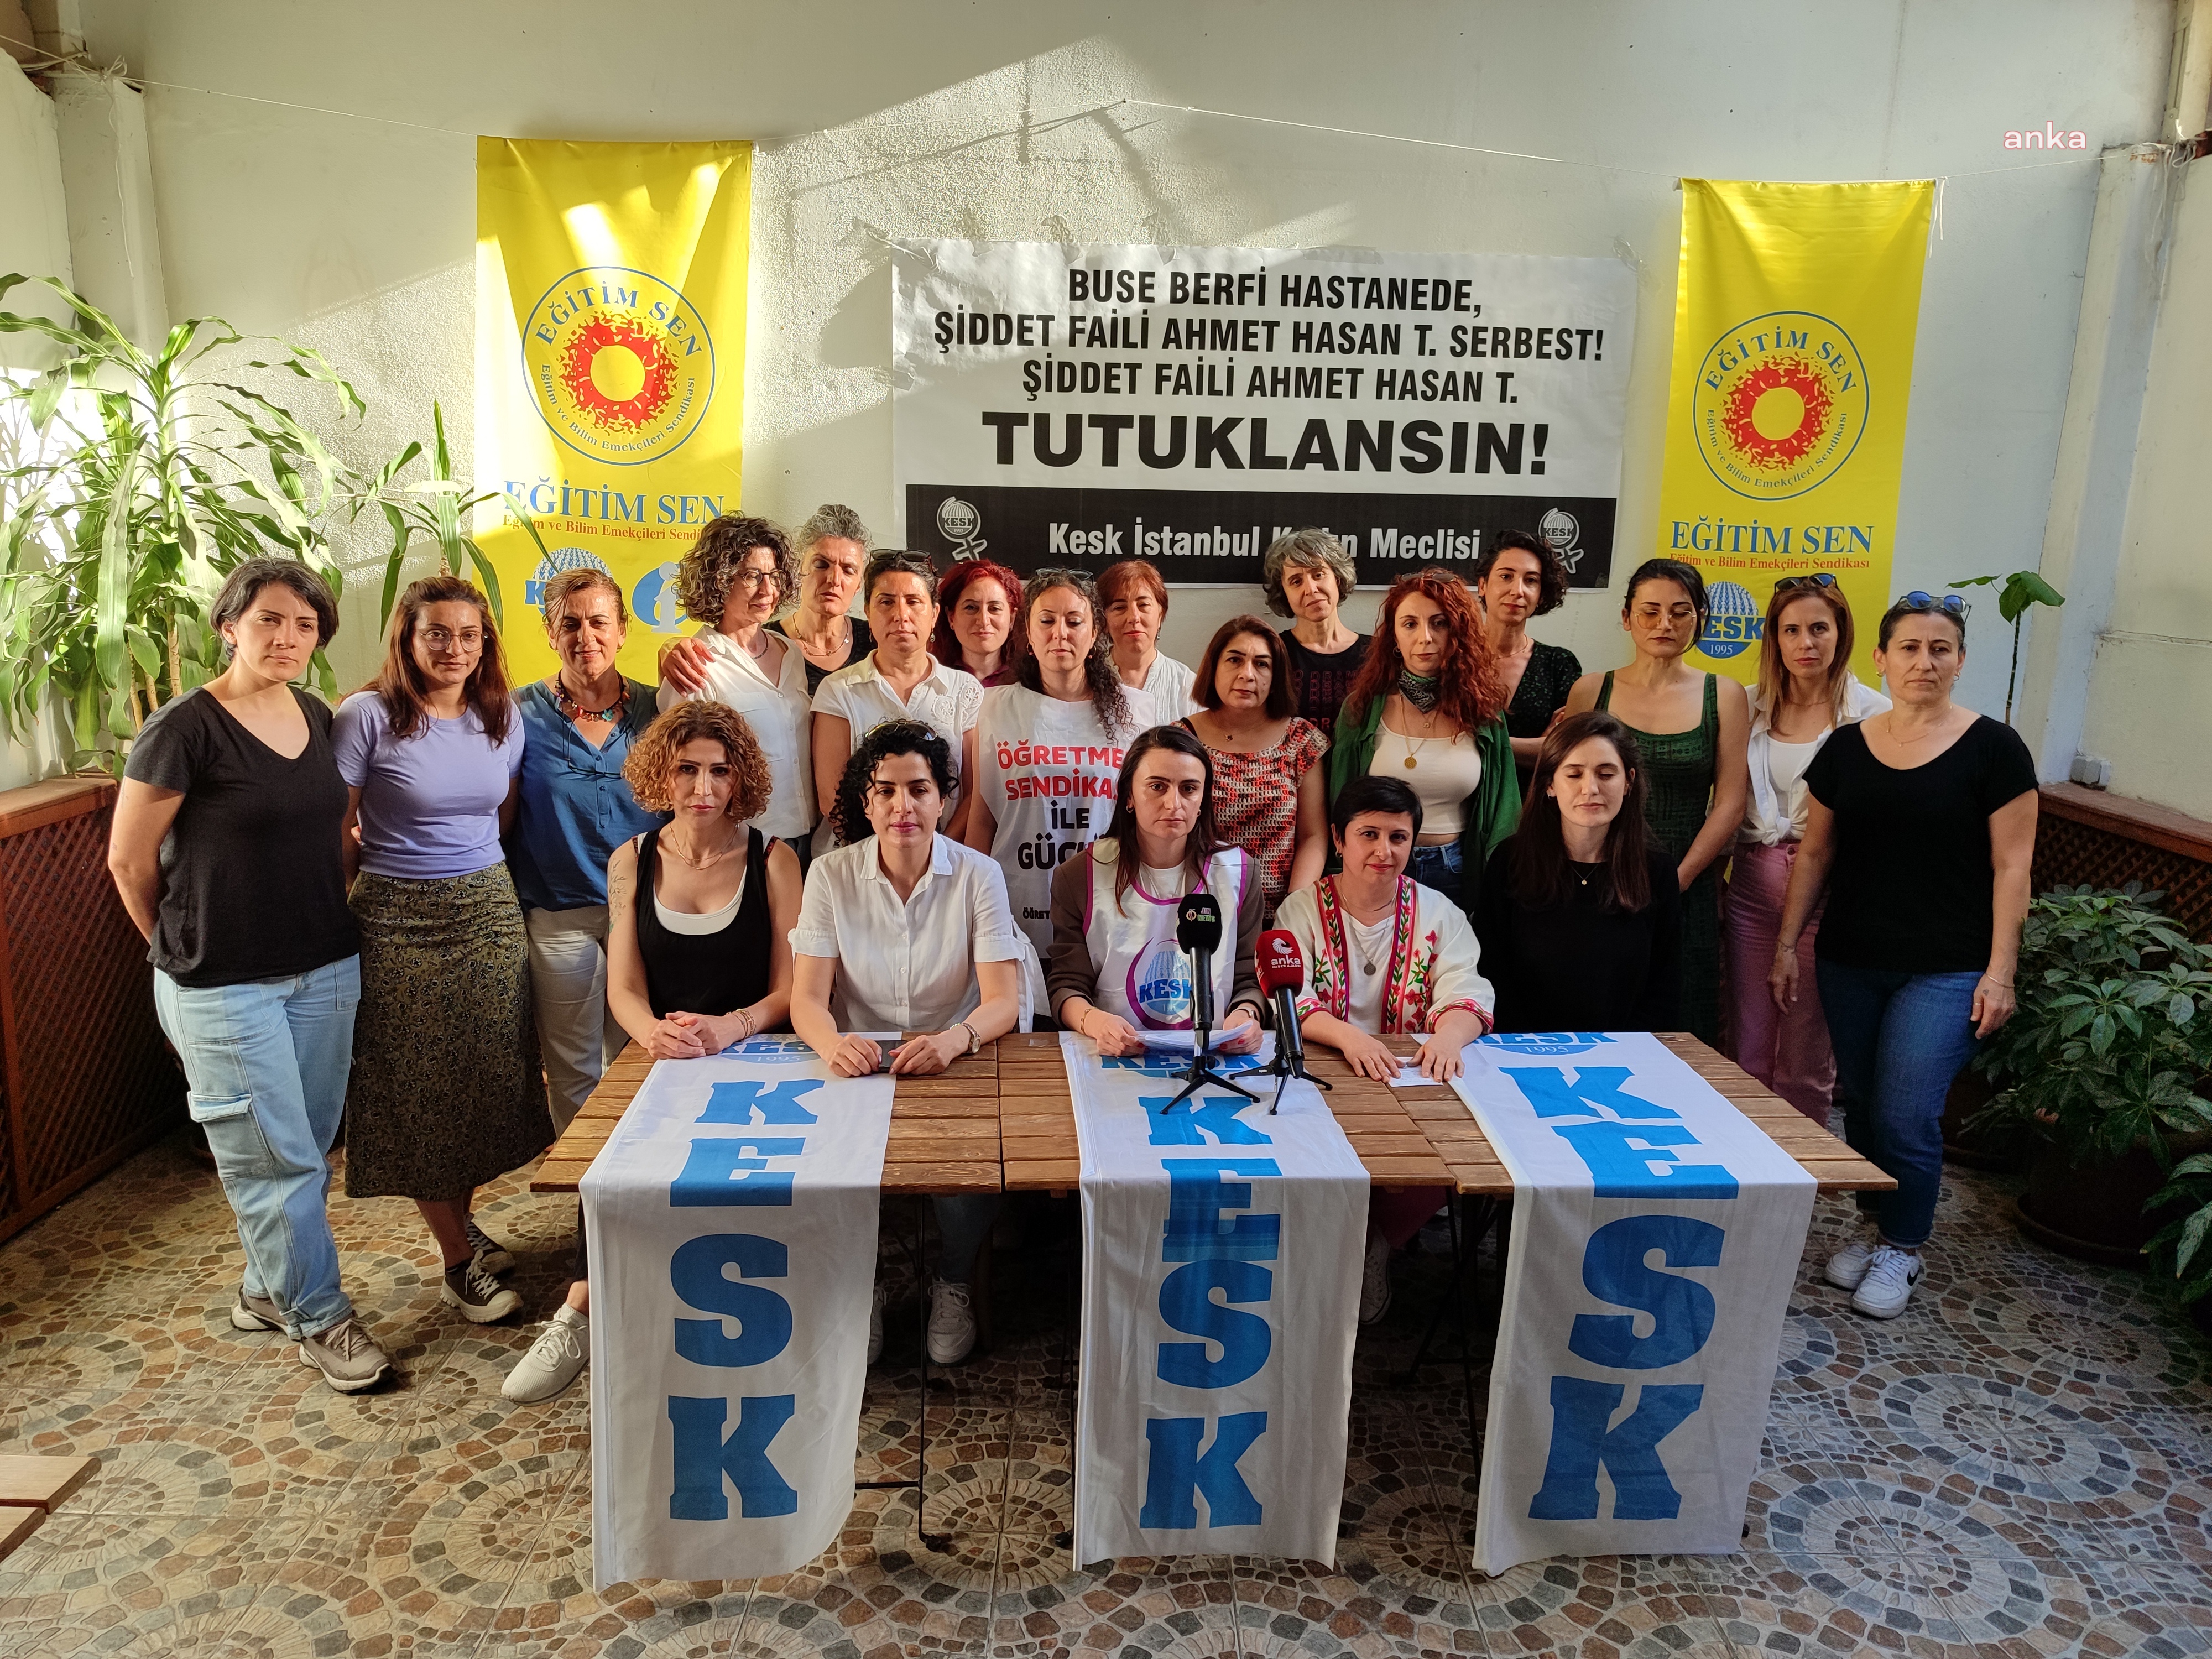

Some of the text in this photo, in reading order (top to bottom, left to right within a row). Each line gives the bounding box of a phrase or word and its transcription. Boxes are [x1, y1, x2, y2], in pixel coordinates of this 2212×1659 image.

[1069, 266, 1481, 318] BUSE BERFİ HASTANEDE,
[535, 281, 702, 357] EĞİTİM SEN
[934, 304, 1604, 361] ŞİDDET FAİLİ AHMET HASAN T. SERBEST!
[1022, 352, 1517, 403] ŞİDDET FAİLİ AHMET HASAN T.
[1705, 326, 1857, 393] EĞİTİM SEN
[541, 364, 695, 452] Eğitim ve Bilim Emekçileri Sendikası
[982, 411, 1549, 475] TUTUKLANSIN!
[1717, 450, 1726, 463] ve
[1726, 463, 1751, 483] Bilim
[1754, 466, 1815, 488] Emekçileri
[1815, 413, 1847, 467] Sendikası
[504, 476, 725, 524] EĞİTİM SEN
[549, 522, 562, 531] ve
[565, 521, 598, 535] Bilim
[602, 524, 666, 541] Emekçileri
[669, 528, 702, 540] Sendi
[1049, 523, 1123, 555] Kesk
[1134, 517, 1260, 556] İstanbul
[1370, 528, 1480, 560] Meclisi
[1670, 515, 1875, 554] EĞİTİM SEN
[1718, 556, 1746, 568] Bilim
[1749, 558, 1809, 571] Emekçileri
[1812, 558, 1870, 568] Sendikası
[1703, 615, 1766, 640] ESK
[1710, 644, 1733, 655] 1995
[997, 739, 1128, 770] ÖĞRETME
[1005, 768, 1118, 800] SENDİKA
[1051, 800, 1089, 829] İLE
[1023, 907, 1050, 919] ÖĞRET
[1197, 914, 1215, 922] NEWS
[1271, 954, 1301, 965] anka
[721, 1041, 816, 1054] KES
[667, 1079, 825, 1521] KESK
[1498, 1066, 1739, 1521] KESK
